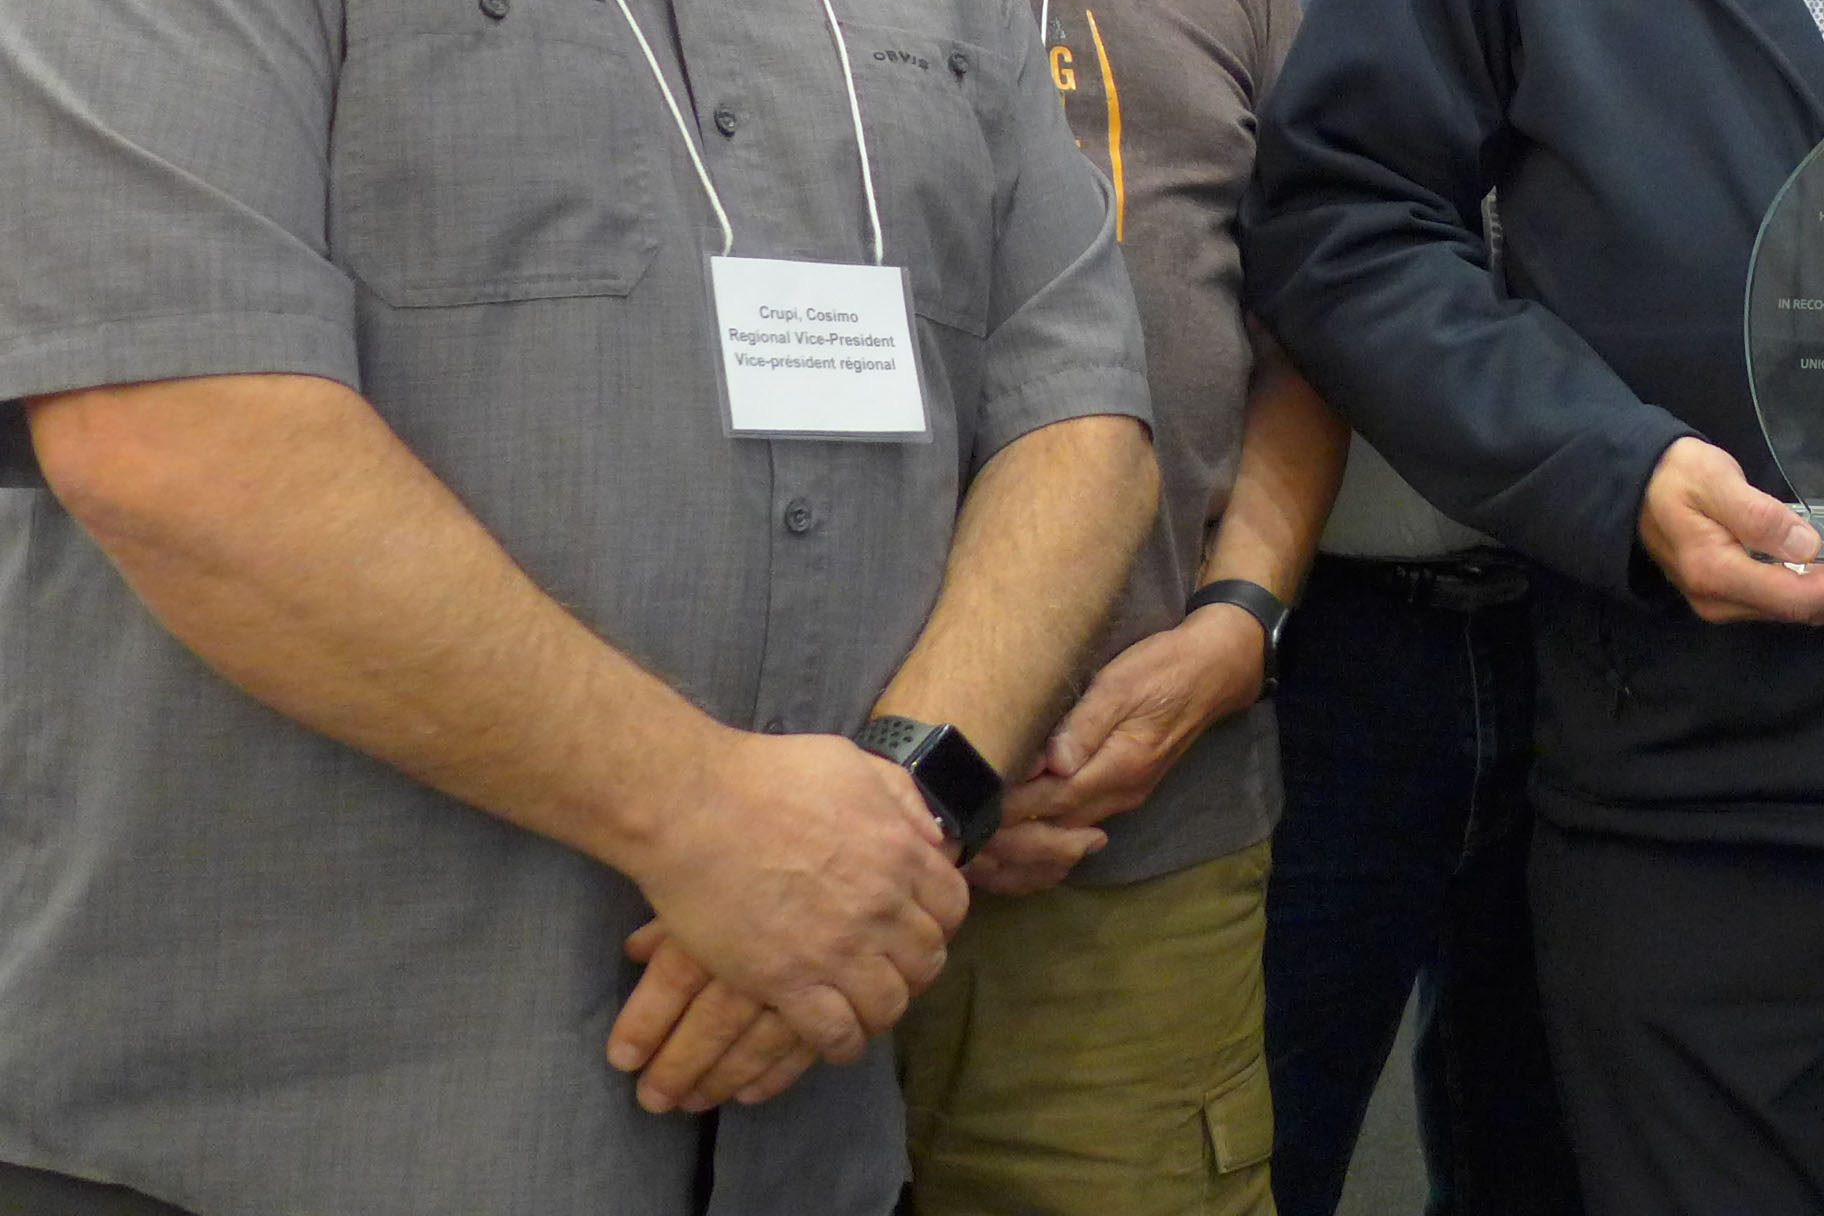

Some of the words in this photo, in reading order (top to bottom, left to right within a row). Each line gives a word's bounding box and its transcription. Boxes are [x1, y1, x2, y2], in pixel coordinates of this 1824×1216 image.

[1778, 298, 1790, 309] IN
[758, 305, 802, 322] Crupi,
[806, 308, 859, 323] Cosimo
[728, 328, 790, 345] Regional
[794, 332, 896, 347] Vice-President
[734, 352, 837, 370] Vice-président
[840, 356, 896, 373] régional
